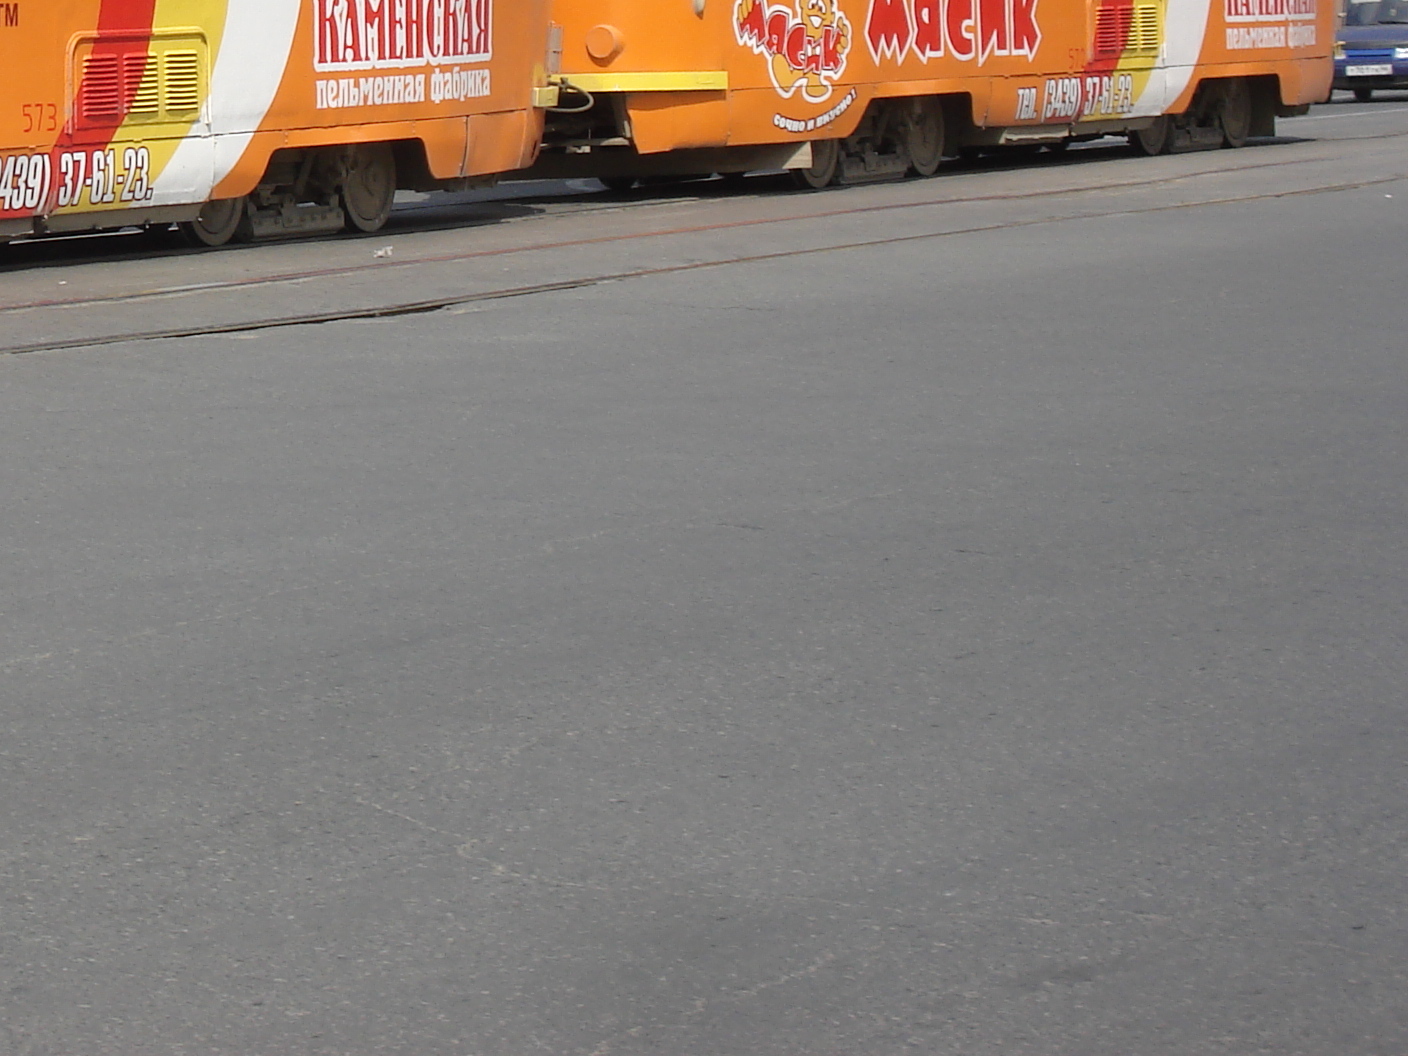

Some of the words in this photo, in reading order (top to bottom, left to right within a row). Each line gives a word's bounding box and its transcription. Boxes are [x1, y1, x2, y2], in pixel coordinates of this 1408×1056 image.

[315, 73, 426, 110] пельменная
[430, 65, 492, 104] фабрика
[1040, 76, 1083, 123] (3439)
[22, 103, 57, 133] 573
